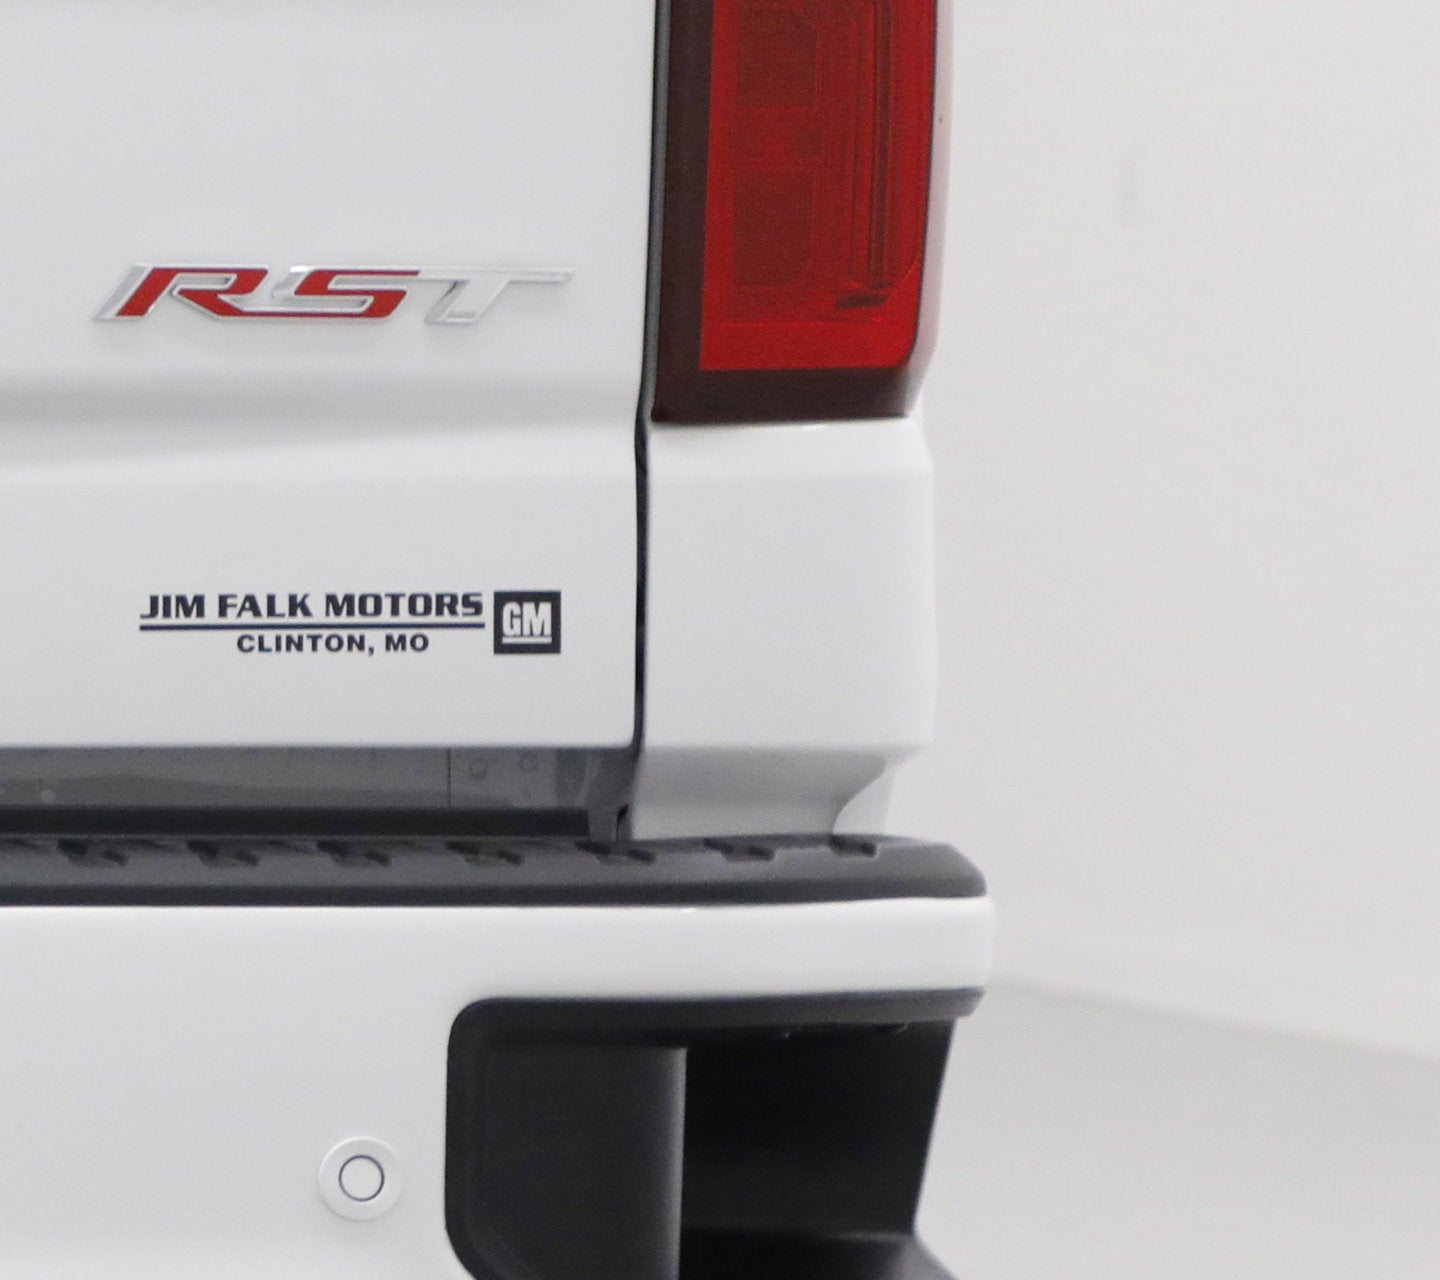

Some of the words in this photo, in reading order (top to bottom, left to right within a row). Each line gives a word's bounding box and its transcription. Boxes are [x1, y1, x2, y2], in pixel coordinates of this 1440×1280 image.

[93, 263, 574, 324] RST
[139, 593, 206, 619] JIM
[217, 592, 314, 619] FALK
[324, 591, 484, 618] MOTORS
[501, 601, 553, 638] GM
[236, 634, 375, 656] CLINTON,
[385, 634, 430, 653] MO
